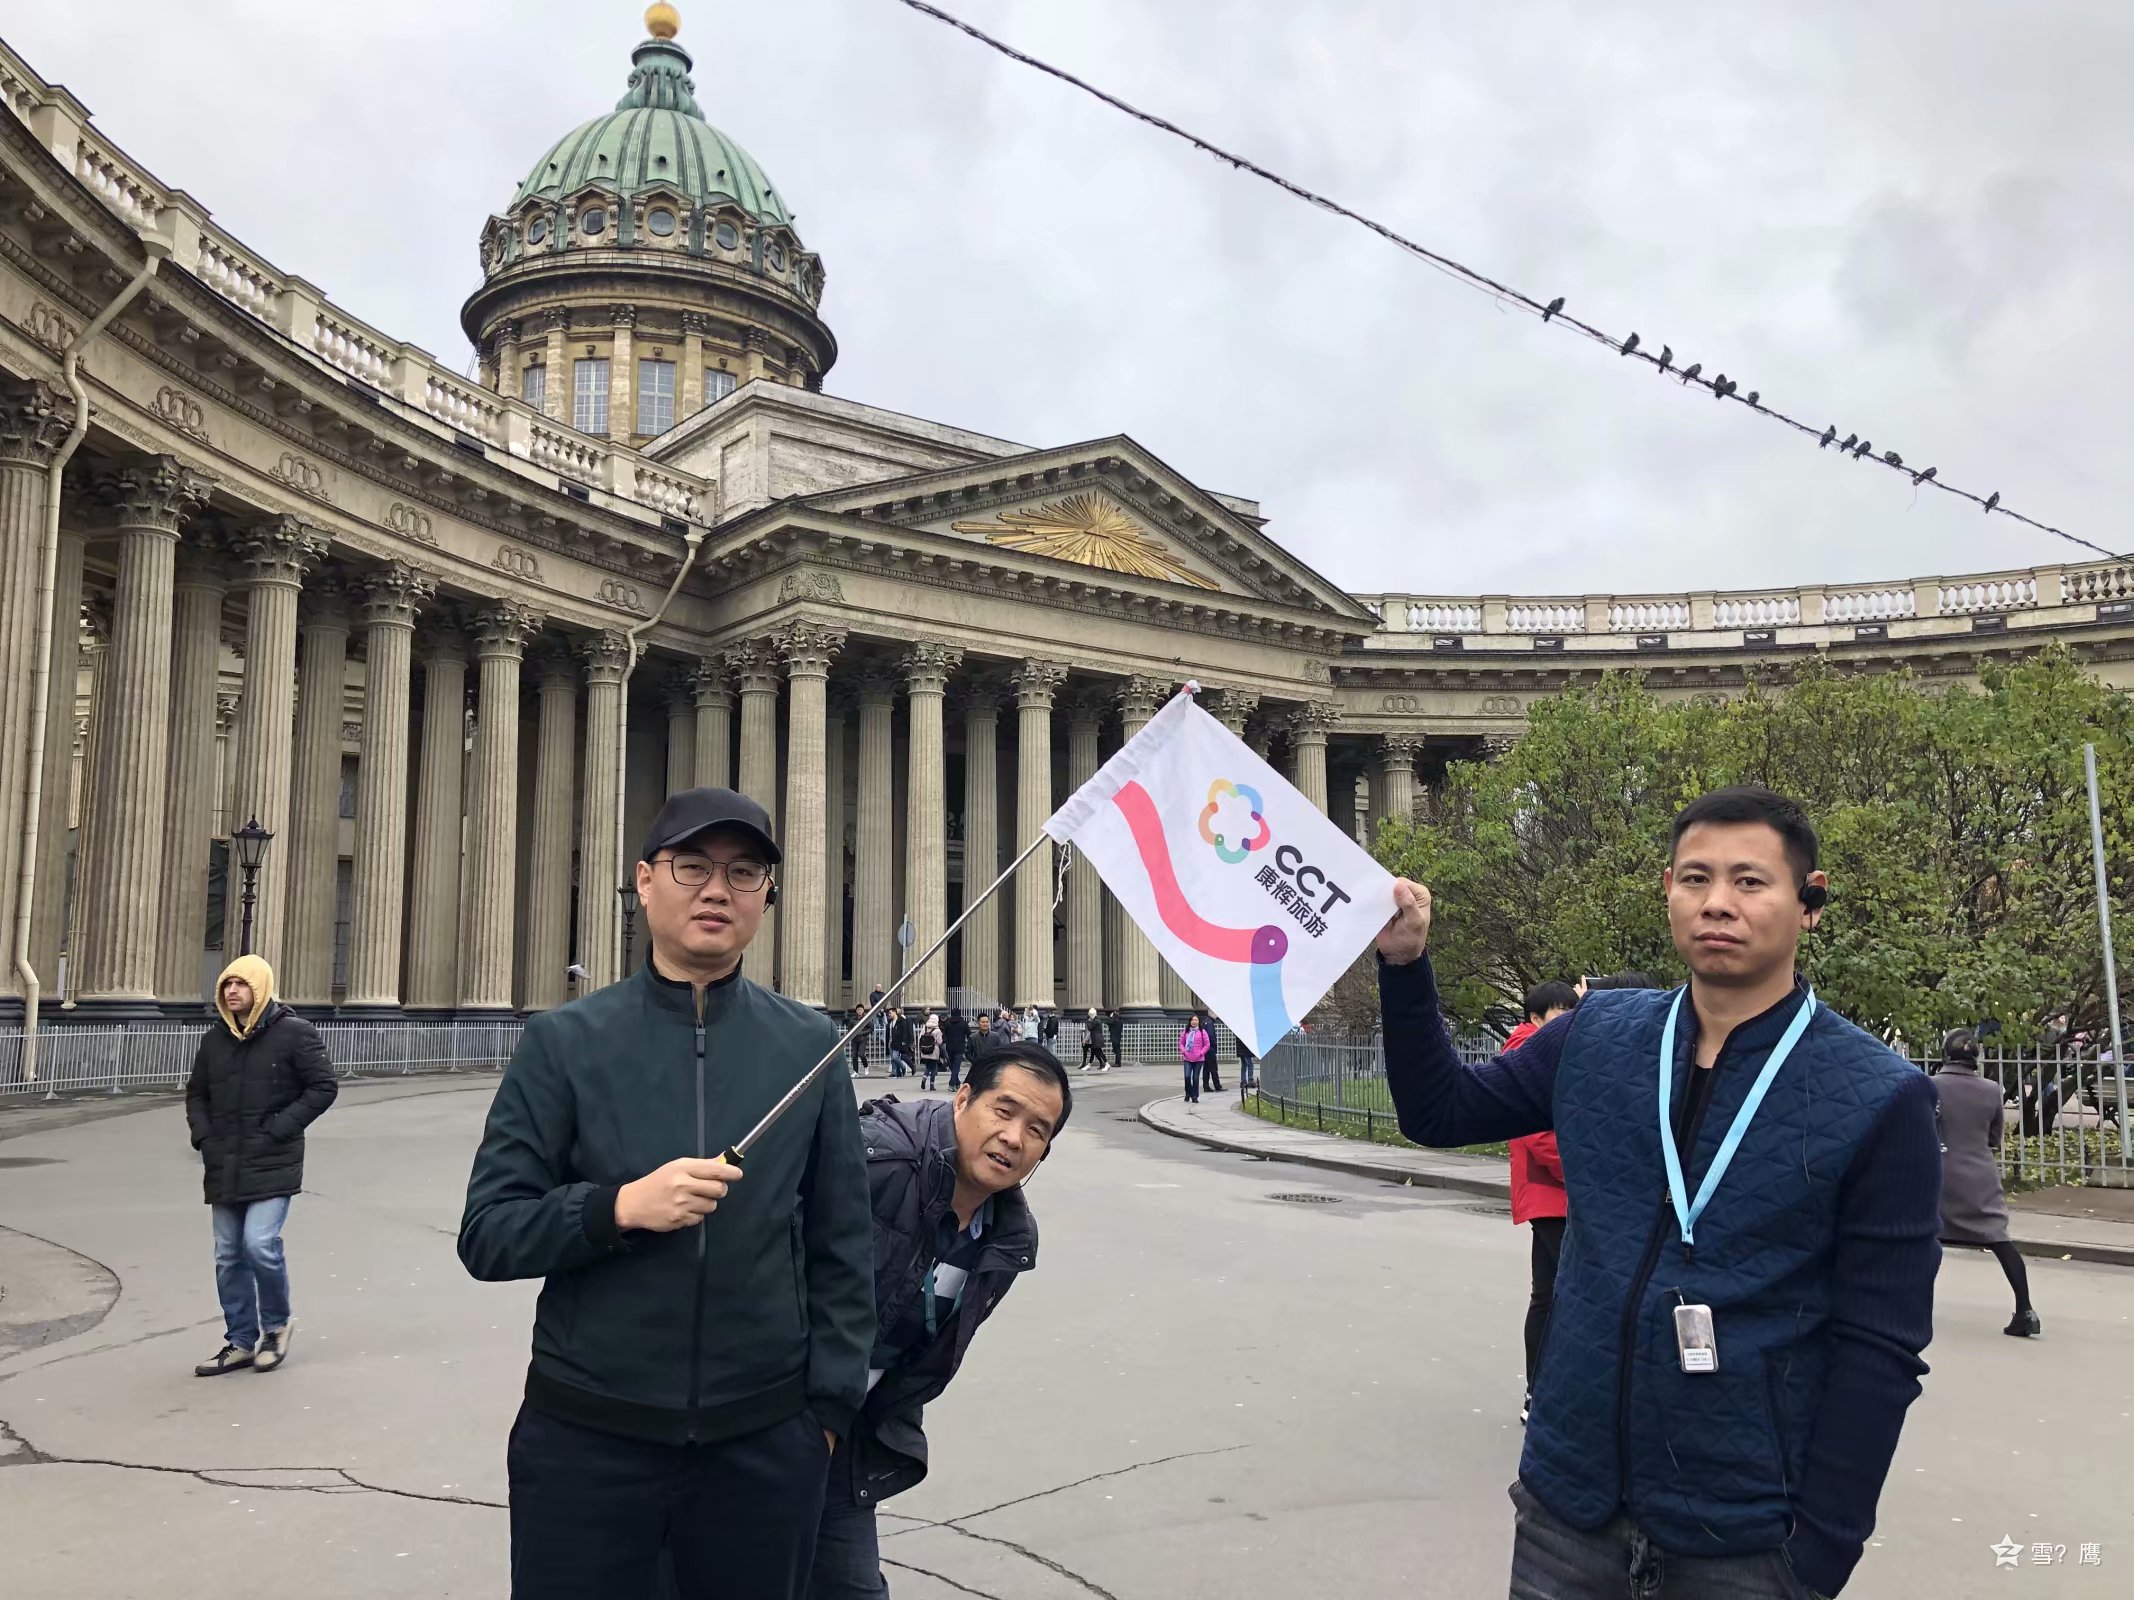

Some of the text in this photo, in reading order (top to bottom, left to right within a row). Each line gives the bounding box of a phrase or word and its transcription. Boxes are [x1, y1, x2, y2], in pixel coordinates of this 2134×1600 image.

[1254, 864, 1328, 938] 康辉旅游
[1275, 844, 1351, 914] CCT
